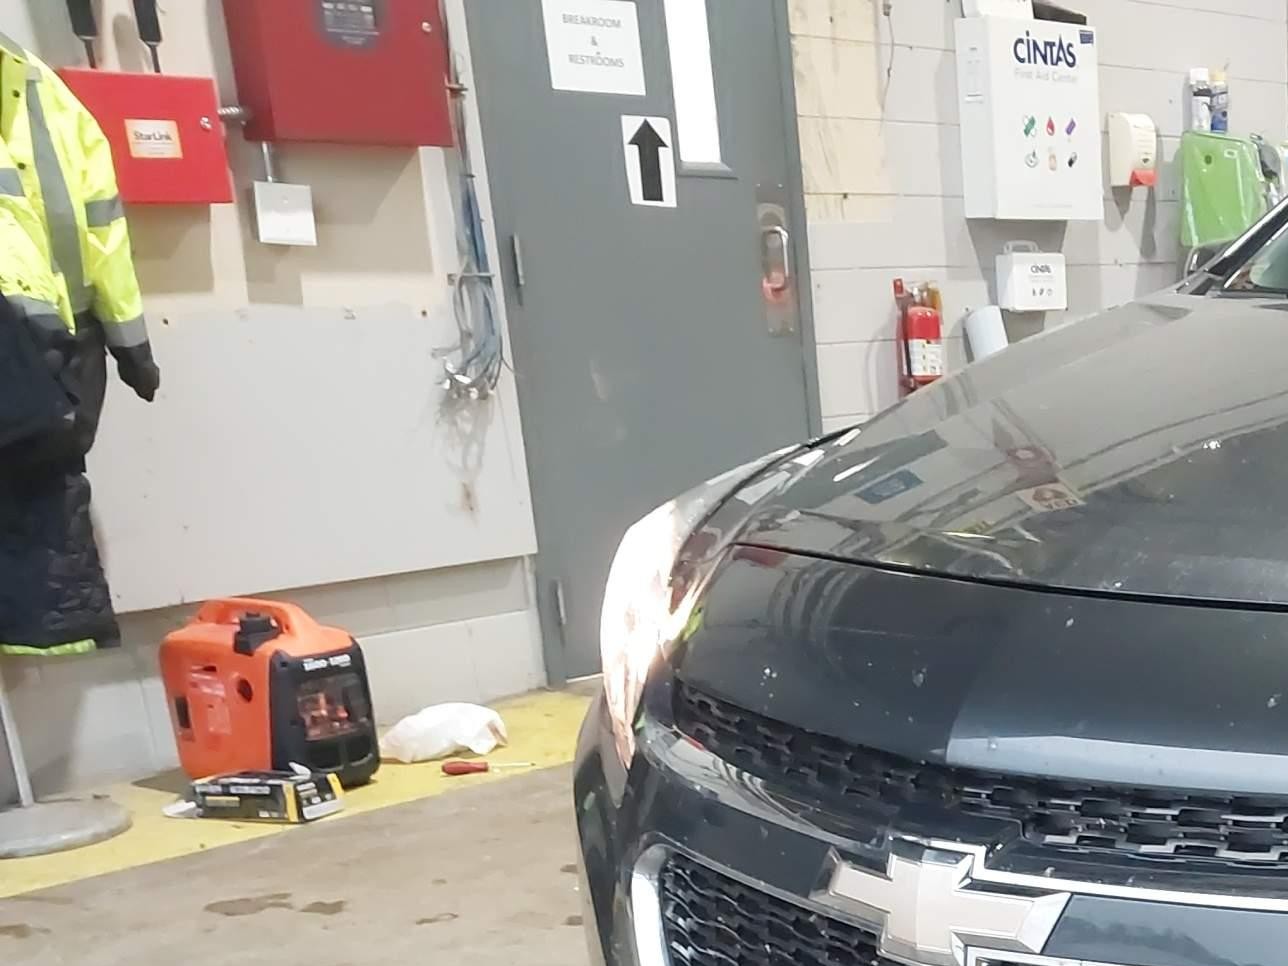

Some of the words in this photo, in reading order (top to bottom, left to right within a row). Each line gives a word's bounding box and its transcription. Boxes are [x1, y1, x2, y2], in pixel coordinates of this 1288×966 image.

[562, 13, 621, 28] BREAKROOM
[590, 35, 599, 47] &
[1013, 29, 1077, 68] CINTAS
[567, 54, 625, 68] RESTROOMS
